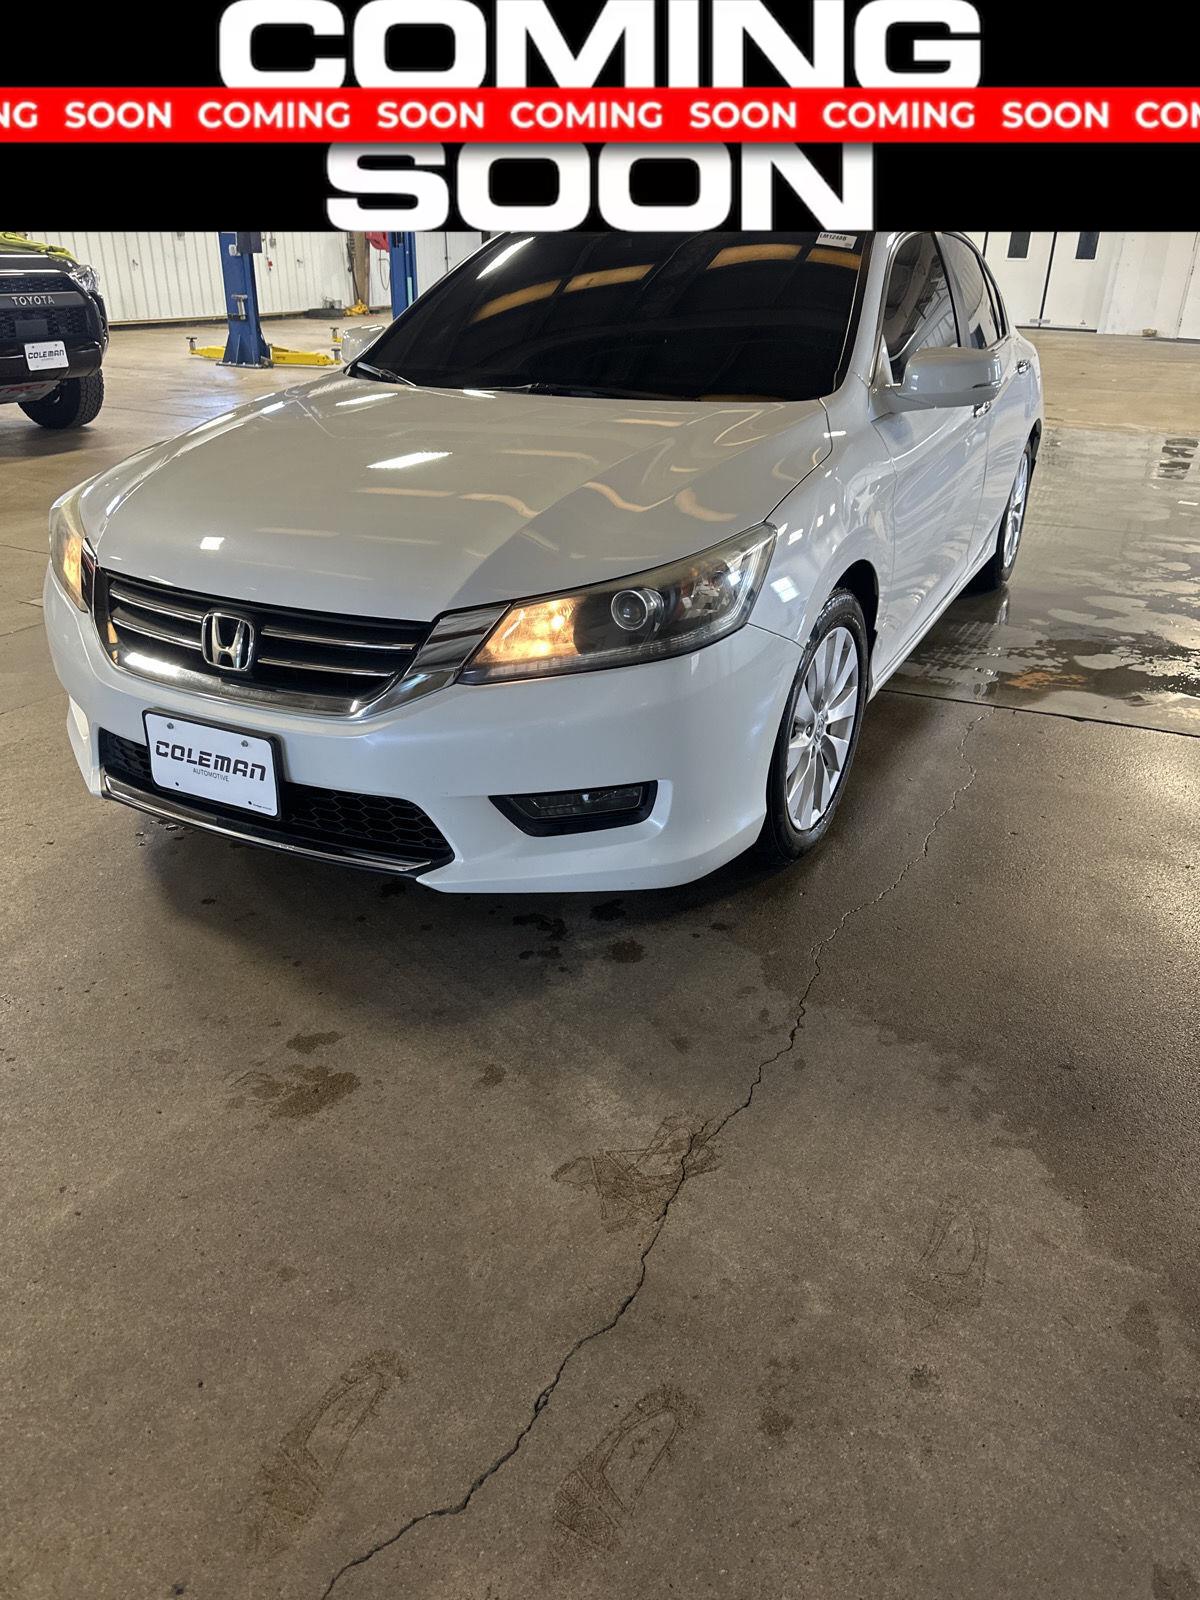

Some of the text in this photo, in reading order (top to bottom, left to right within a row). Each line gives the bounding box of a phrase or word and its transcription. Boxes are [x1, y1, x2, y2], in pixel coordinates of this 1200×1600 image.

[11, 295, 55, 305] TOYOTA
[28, 349, 65, 359] COLEMAN
[155, 740, 267, 782] COLEMAN
[192, 767, 230, 783] AUTOMOTIVE
